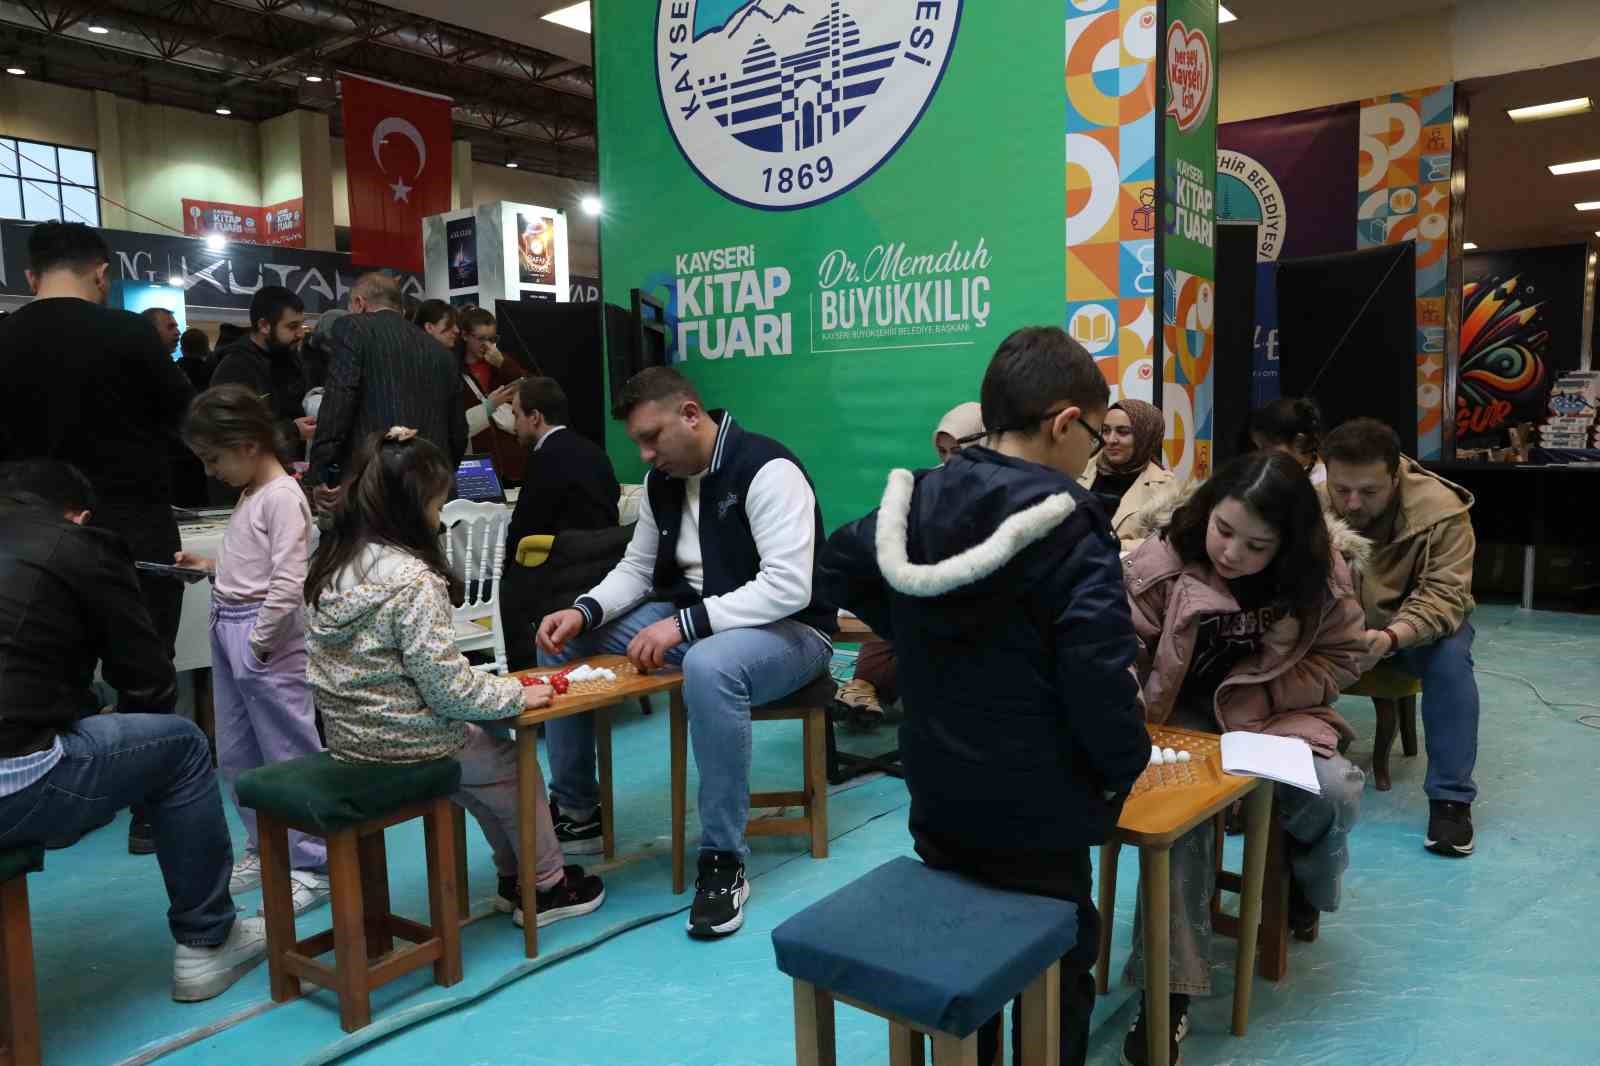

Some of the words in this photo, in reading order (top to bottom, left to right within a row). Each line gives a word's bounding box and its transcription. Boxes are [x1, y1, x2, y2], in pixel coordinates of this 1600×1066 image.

[762, 156, 834, 194] 1869
[1176, 176, 1214, 217] KİTAP
[1176, 206, 1214, 248] FUARI
[675, 244, 755, 275] KAYSERİ
[818, 249, 860, 289] Dr.
[863, 236, 993, 283] Memduh
[676, 266, 792, 319] KİTAP
[821, 275, 991, 331] BÜYÜKKILIÇ
[677, 312, 793, 362] FUARI
